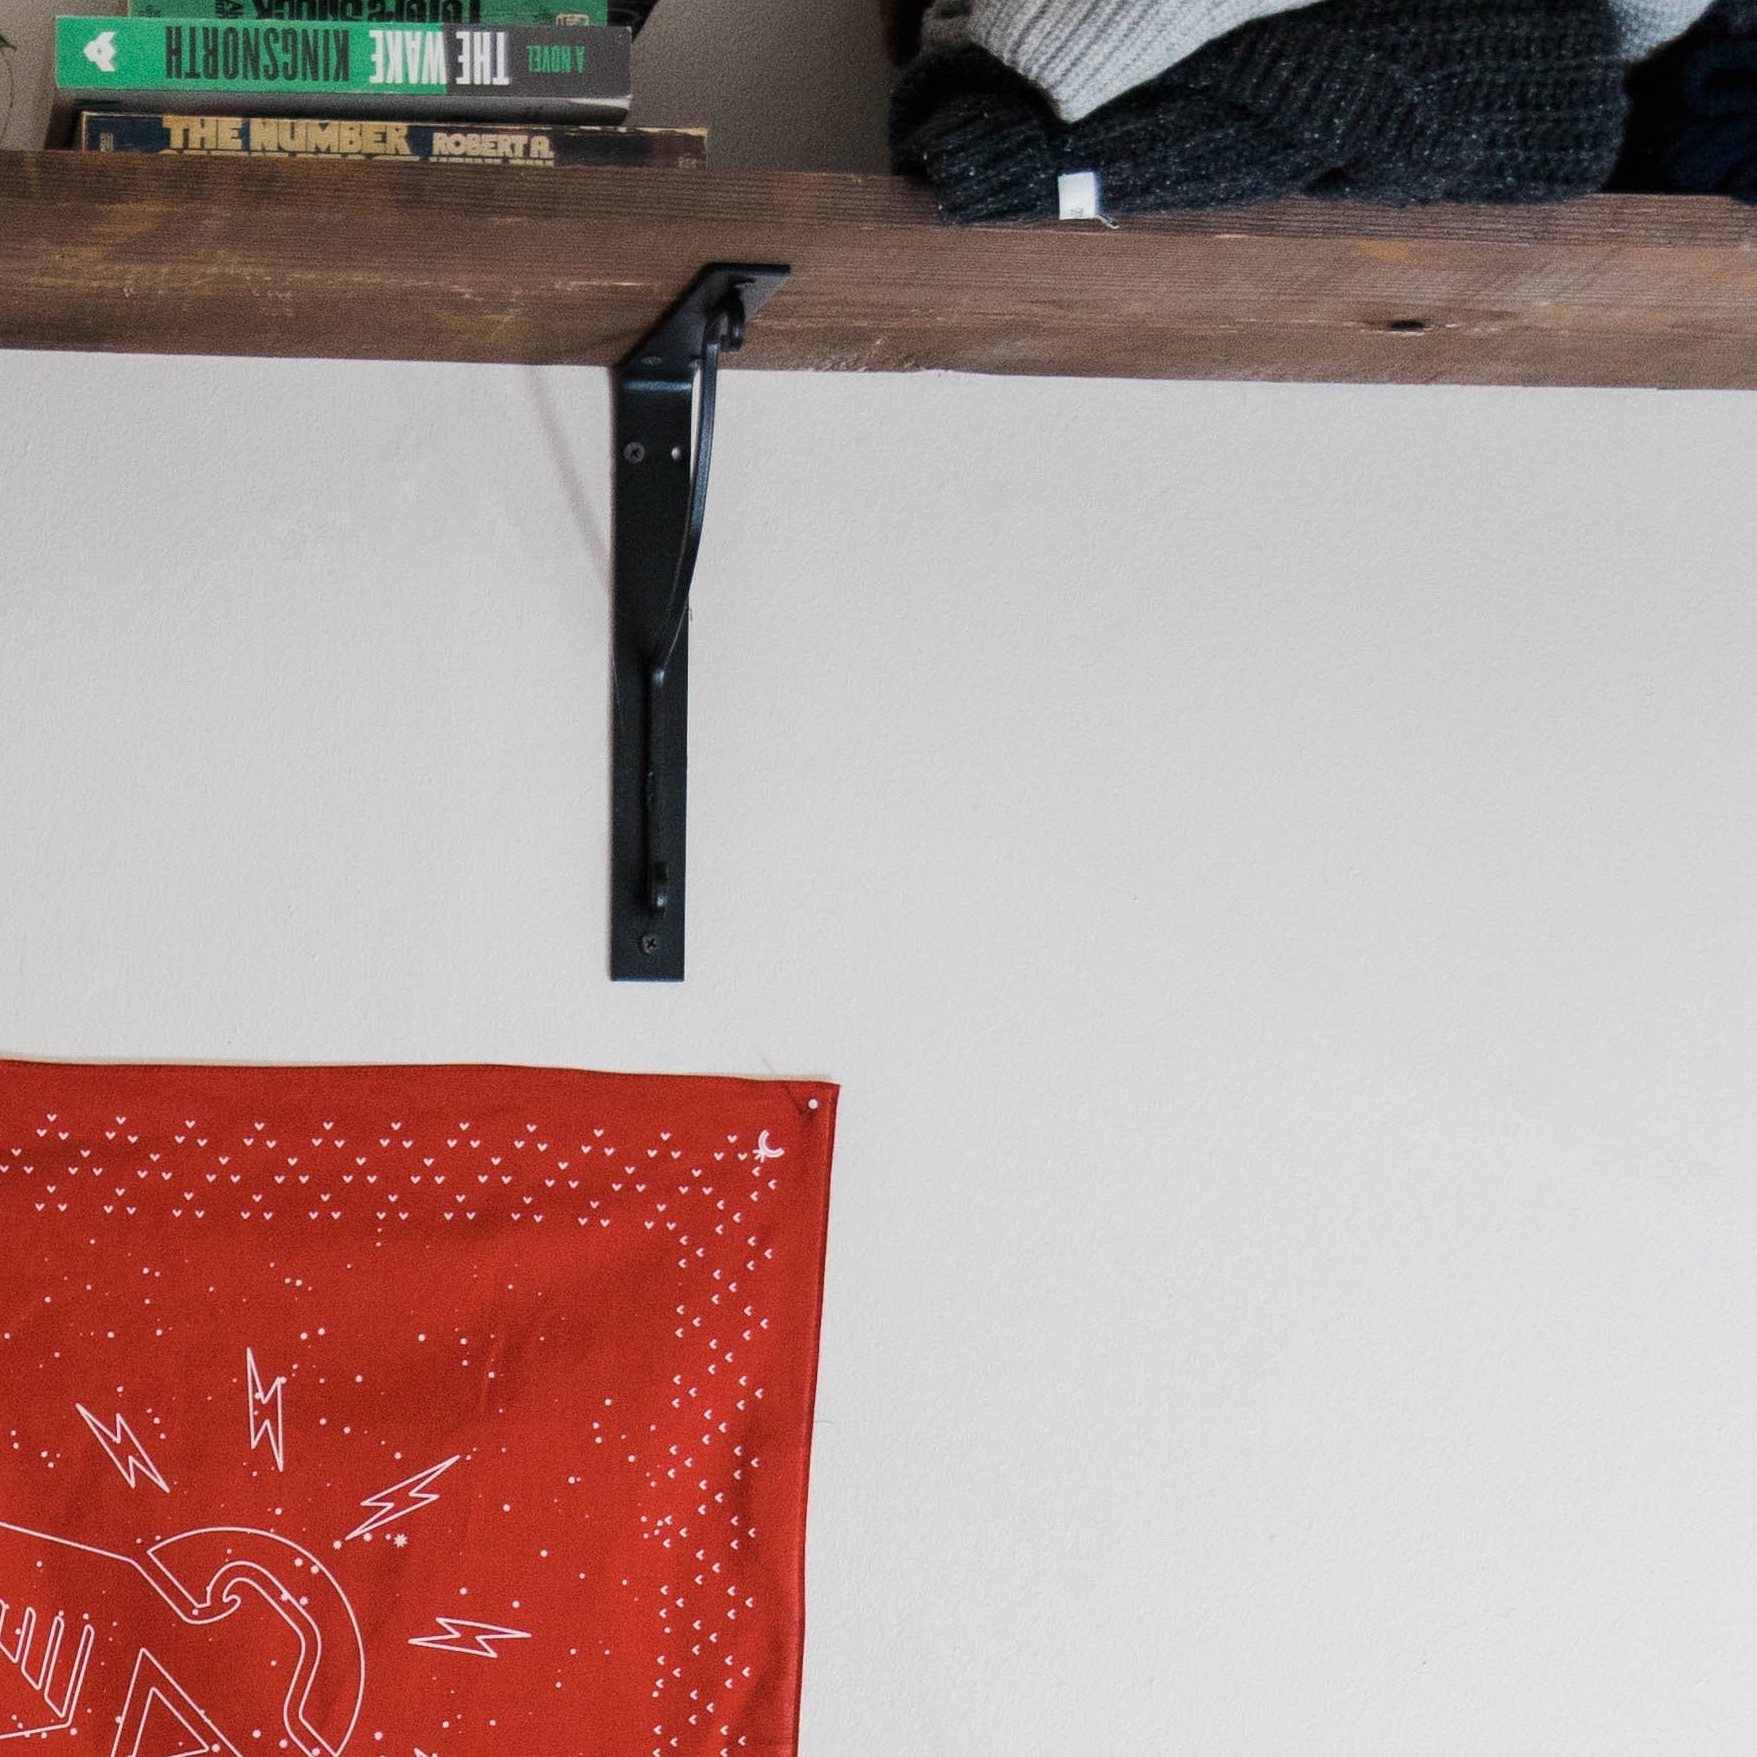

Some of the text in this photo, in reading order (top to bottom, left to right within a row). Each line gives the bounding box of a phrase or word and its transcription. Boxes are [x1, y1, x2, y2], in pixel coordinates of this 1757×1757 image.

[165, 25, 586, 85] A NOVEL THE WAKE KINGSNORTH
[157, 114, 555, 158] THE NUMBER ROBERT A.
